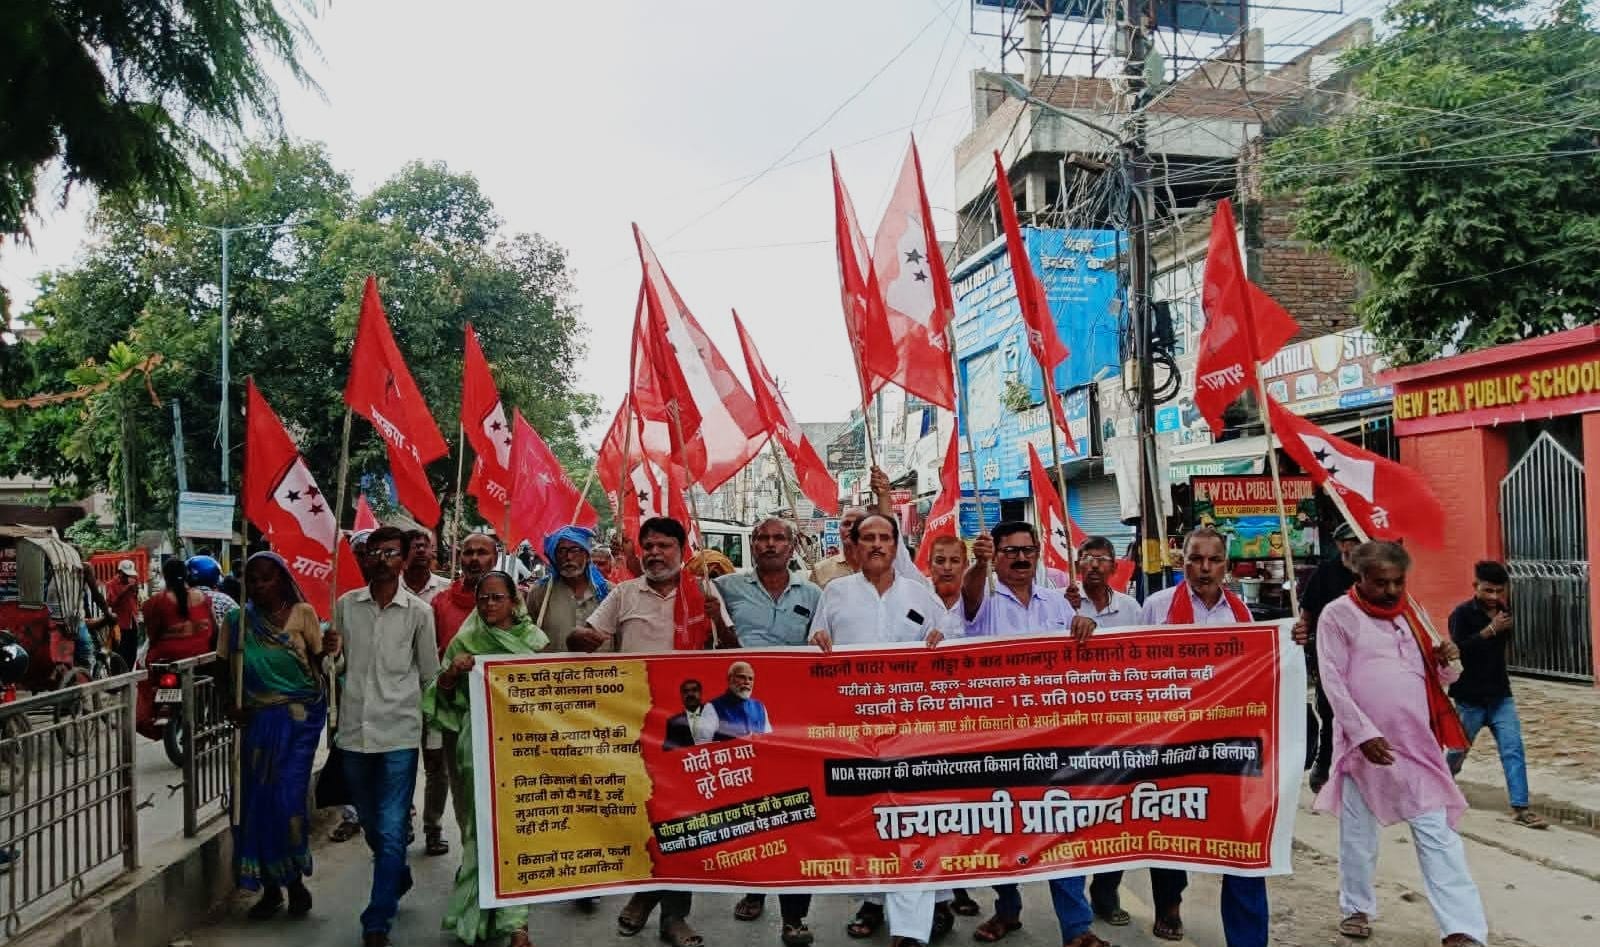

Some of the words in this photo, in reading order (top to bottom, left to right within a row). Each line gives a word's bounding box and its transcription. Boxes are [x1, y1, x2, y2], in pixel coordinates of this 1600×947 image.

[1393, 392, 1424, 420] NEW
[1428, 385, 1461, 416] ERA
[1464, 374, 1524, 410] PUBLIC
[1193, 480, 1222, 502] NEW
[1222, 481, 1245, 501] ERA
[1246, 480, 1279, 501] PUBLI
[1128, 639, 1141, 660] के
[531, 670, 550, 682] प्रति
[552, 668, 581, 685] यूनिट
[584, 666, 618, 680] बिजली
[838, 683, 871, 698] गरीबों
[873, 682, 885, 696] के
[1018, 673, 1031, 687] के
[1033, 673, 1063, 686] भवन
[1066, 666, 1106, 684] निर्माण
[1109, 667, 1121, 682] के
[1124, 667, 1148, 682] लिए
[1151, 665, 1188, 681] जमीन
[1190, 664, 1216, 681] नहीं
[538, 684, 552, 697] को
[555, 685, 593, 697] सालाना
[595, 683, 624, 694] 5000
[538, 701, 552, 713] का
[554, 699, 596, 714] नुकसान
[855, 698, 896, 716] अडानी
[900, 698, 914, 714] के
[918, 695, 945, 711] लिए
[949, 692, 993, 710] सौगात
[1042, 688, 1067, 706] प्रति
[1071, 691, 1106, 704] 1050
[1110, 689, 1143, 705] एकड़
[861, 721, 873, 737] के
[899, 720, 911, 735] को
[937, 720, 957, 733] जाए
[960, 714, 977, 732] और
[979, 713, 1015, 731] किसानों
[1016, 713, 1030, 729] को
[1034, 711, 1060, 728] अपनी
[1061, 710, 1088, 727] जमीन
[1091, 712, 1103, 725] पर
[1164, 707, 1186, 723] रखने
[1189, 709, 1203, 722] का
[1206, 704, 1243, 721] अधिकार
[1246, 701, 1267, 717] मिले
[512, 732, 523, 742] 10
[612, 725, 626, 739] की
[595, 742, 611, 754] की
[682, 748, 710, 773] मोदी
[714, 748, 731, 766] का
[734, 744, 756, 760] यार
[831, 766, 855, 781] NDA
[857, 765, 891, 781] सरकार
[894, 762, 909, 780] की
[984, 755, 1021, 773] किसान
[1023, 752, 1058, 771] विरोधी
[1069, 751, 1120, 770] पर्यावरणी
[1123, 750, 1159, 769] विरोधी
[1161, 746, 1196, 766] नीतियों
[1198, 746, 1210, 761] के
[514, 775, 537, 788] जिन
[580, 773, 592, 785] की
[594, 773, 626, 786] जमीन
[696, 772, 717, 800] लूटे
[719, 766, 753, 789] बिहार
[550, 788, 564, 800] को
[566, 787, 576, 799] दी
[562, 804, 573, 815] या
[576, 804, 597, 814] अन्य
[659, 822, 685, 838] पीएम
[687, 814, 709, 831] मोदी
[710, 812, 723, 826] का
[725, 807, 740, 823] एक
[742, 803, 756, 818] पेड़
[770, 796, 782, 810] के
[783, 791, 810, 807] नाम?
[873, 789, 1014, 840] राज्यव्यापी
[1131, 781, 1208, 821] दिवस
[538, 820, 549, 832] दी
[687, 833, 697, 848] के
[698, 829, 718, 846] लिए
[719, 827, 730, 840] 10
[731, 821, 755, 837] लाख
[757, 817, 769, 832] पेड़
[770, 810, 789, 827] काटे
[791, 809, 803, 822] जा
[804, 804, 817, 820] रहे
[518, 849, 558, 866] किसानों
[560, 850, 575, 861] पर
[702, 858, 715, 871] 22
[760, 839, 788, 859] 2025
[800, 857, 850, 877] भाकपा
[868, 852, 899, 875] माले
[939, 849, 1000, 872] दरभंगा
[1090, 832, 1144, 855] भारतीय
[1148, 830, 1201, 855] किसान
[1205, 838, 1261, 859] महासभा
[559, 863, 576, 878] और
